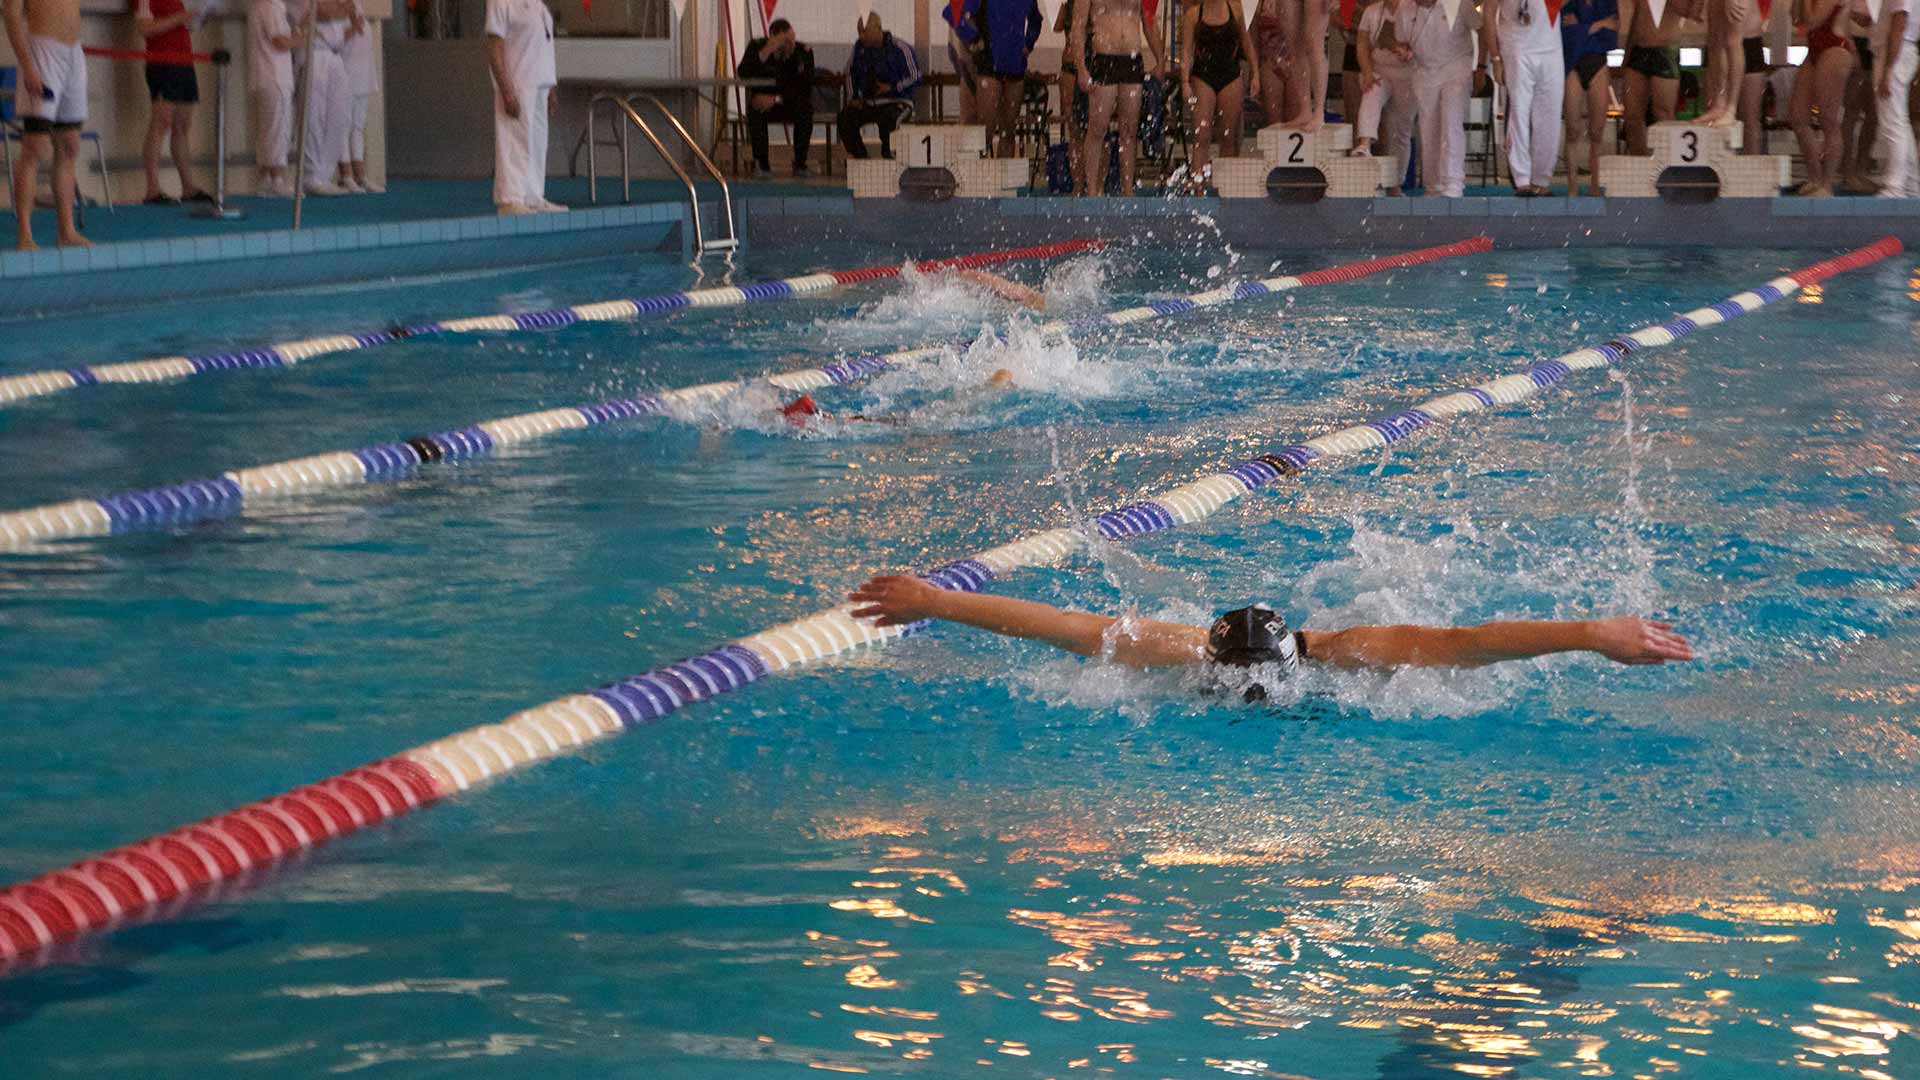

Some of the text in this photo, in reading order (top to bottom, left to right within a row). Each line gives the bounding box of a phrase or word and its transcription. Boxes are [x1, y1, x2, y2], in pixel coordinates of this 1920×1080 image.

[921, 135, 931, 165] 1
[1288, 133, 1305, 163] 2
[1681, 131, 1699, 162] 3
